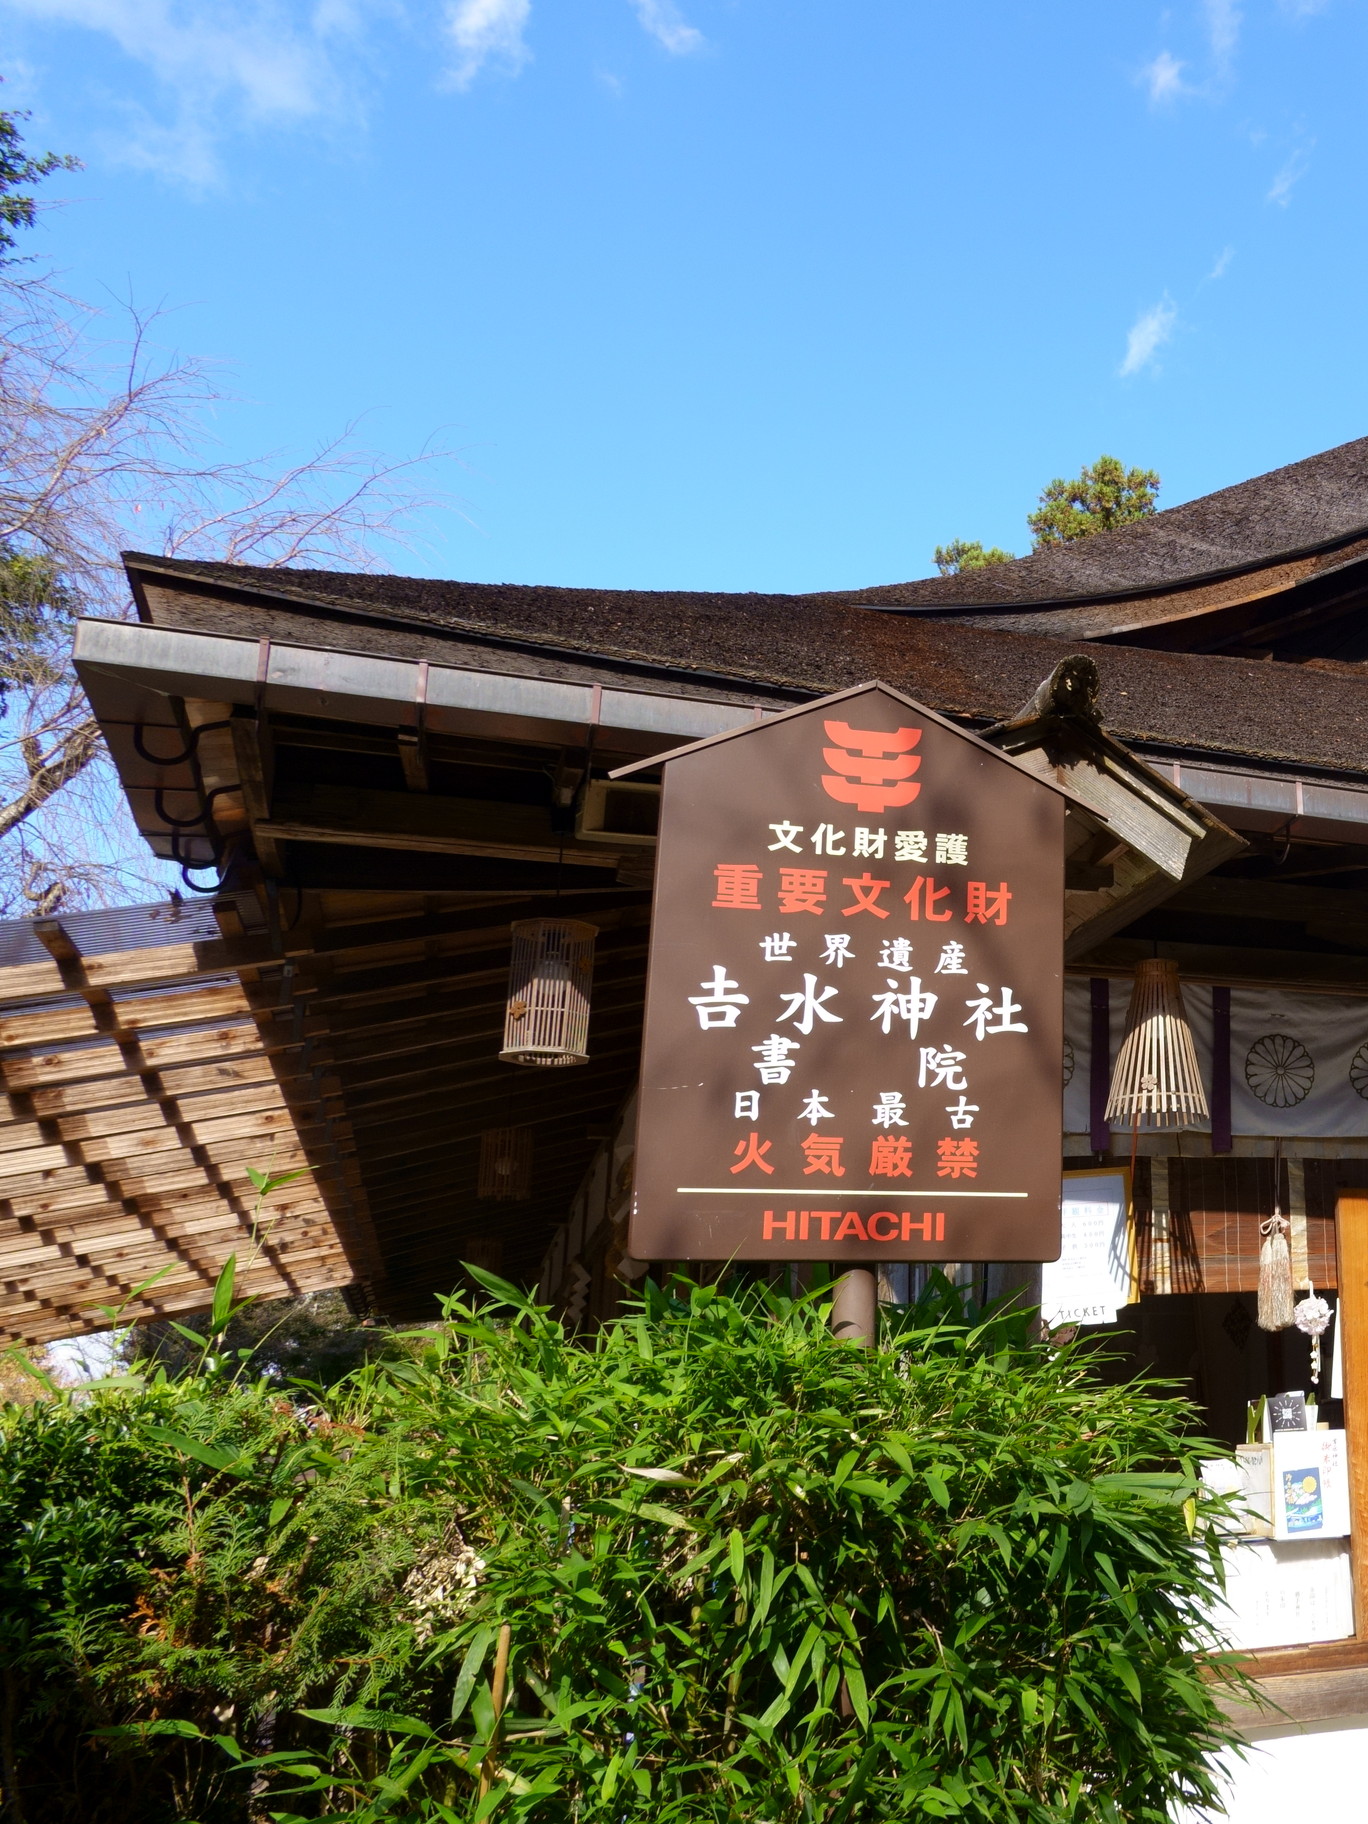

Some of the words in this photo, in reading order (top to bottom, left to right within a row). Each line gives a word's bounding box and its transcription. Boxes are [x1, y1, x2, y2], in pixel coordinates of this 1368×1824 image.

[767, 820, 969, 866] 文化財愛護
[711, 863, 1013, 926] 重要文化財
[759, 932, 969, 976] 世界遺産
[750, 1033, 968, 1091] 書院
[734, 1089, 980, 1130] 日本最古
[729, 1132, 980, 1179] 火気厳禁
[762, 1210, 945, 1241] HITACHI
[1060, 1305, 1106, 1320] TICKET
